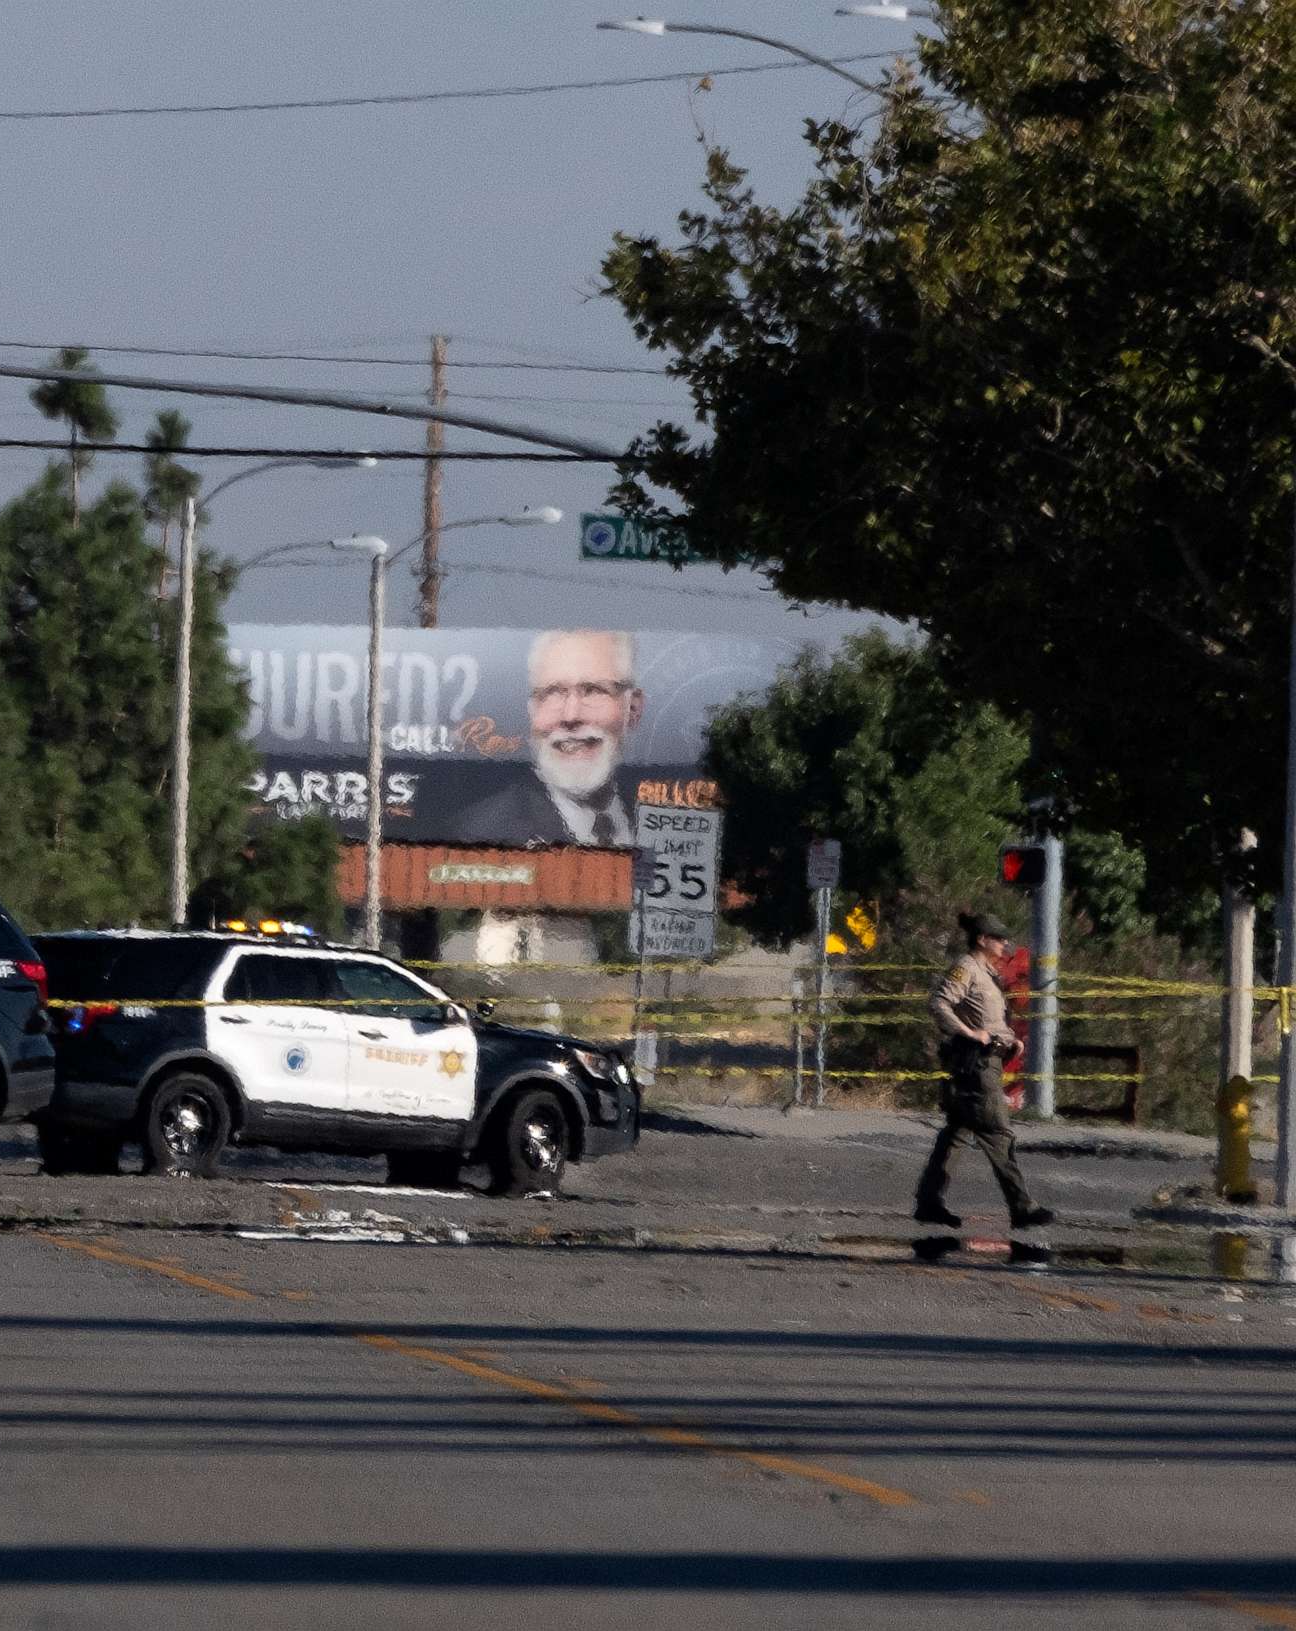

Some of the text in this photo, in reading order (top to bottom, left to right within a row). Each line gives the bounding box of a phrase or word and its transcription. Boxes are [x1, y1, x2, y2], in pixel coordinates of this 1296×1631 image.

[228, 648, 480, 744] JURED?
[389, 724, 455, 755] CALL
[241, 769, 420, 805] PARRS
[644, 813, 712, 834] SPEED
[653, 838, 704, 857] LIMIT
[646, 862, 707, 901] 55
